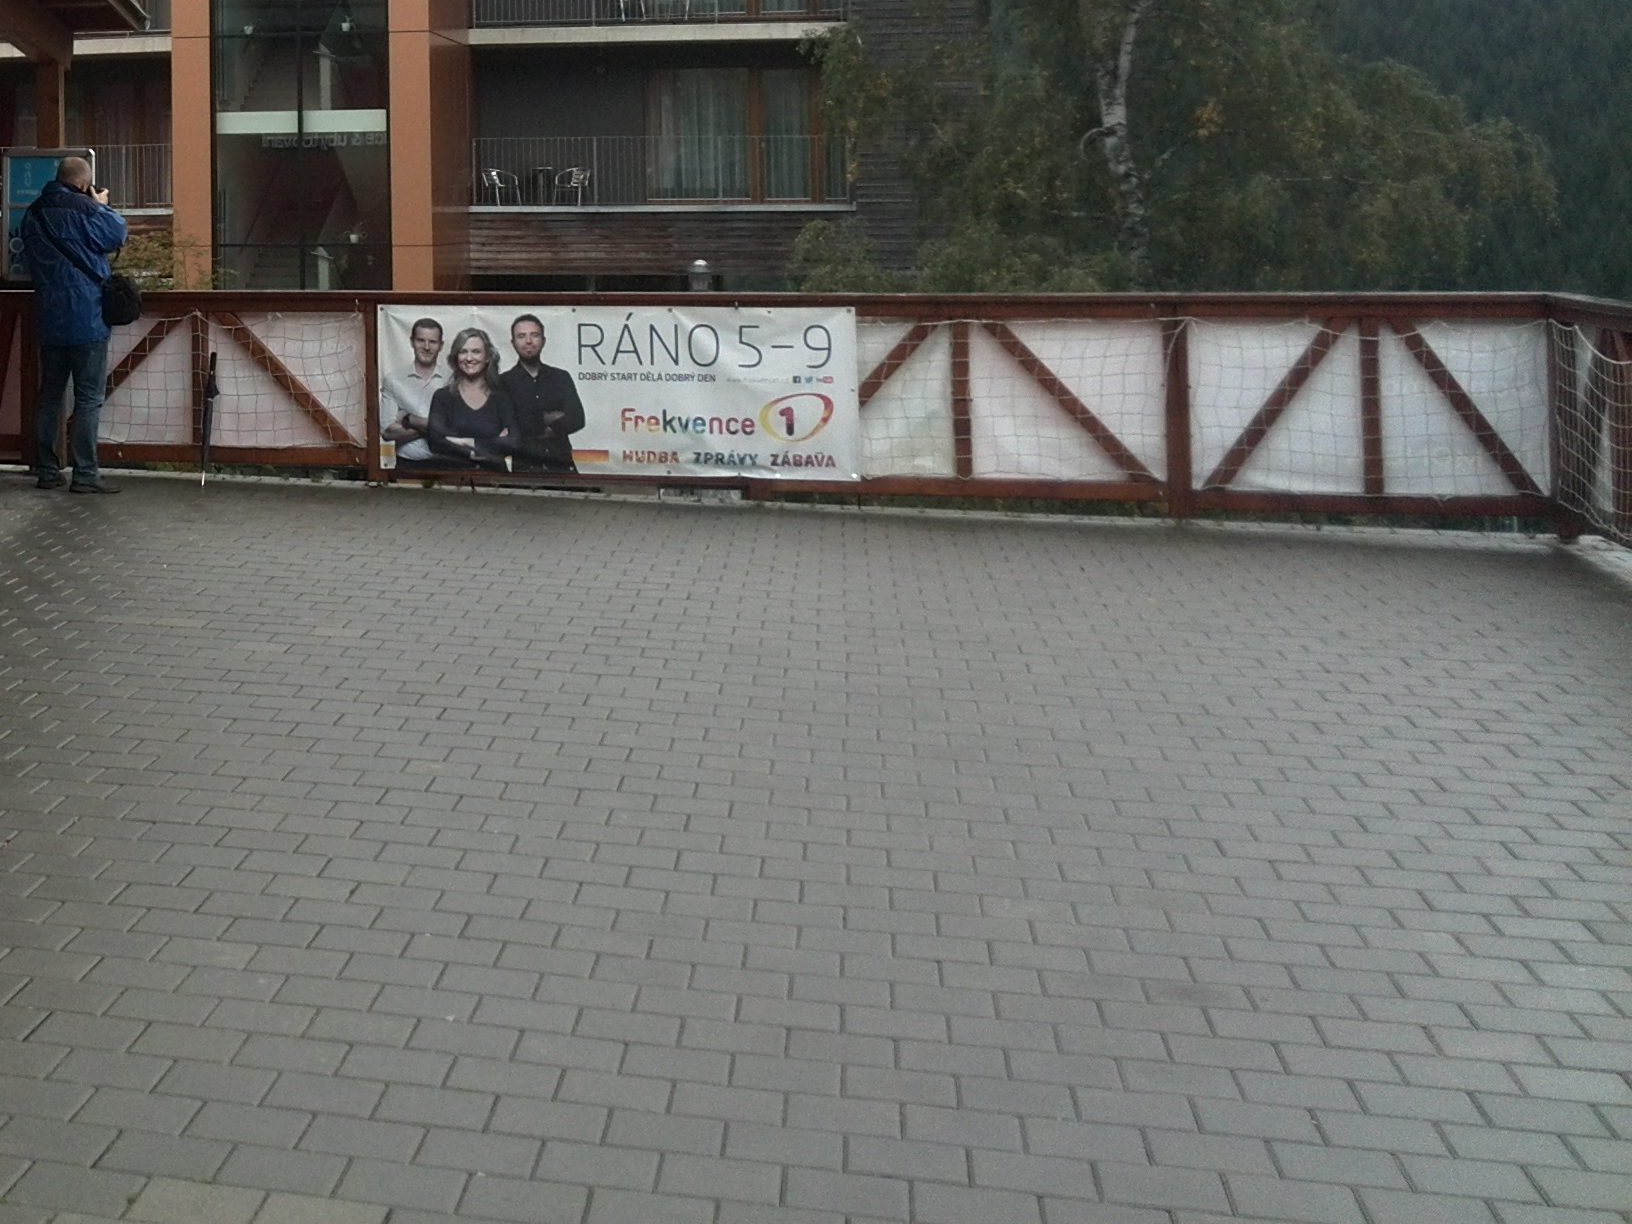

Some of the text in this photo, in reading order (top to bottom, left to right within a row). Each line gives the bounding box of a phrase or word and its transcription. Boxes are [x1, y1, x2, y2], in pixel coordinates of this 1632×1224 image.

[577, 312, 720, 367] RÁNO
[578, 370, 716, 383] DOBRÝ START DĚLÁ DOBRÝ DEN
[621, 406, 795, 437] Frekvence 1
[622, 450, 837, 468] HUDBA ZPRÁVY ZÁBAVA
